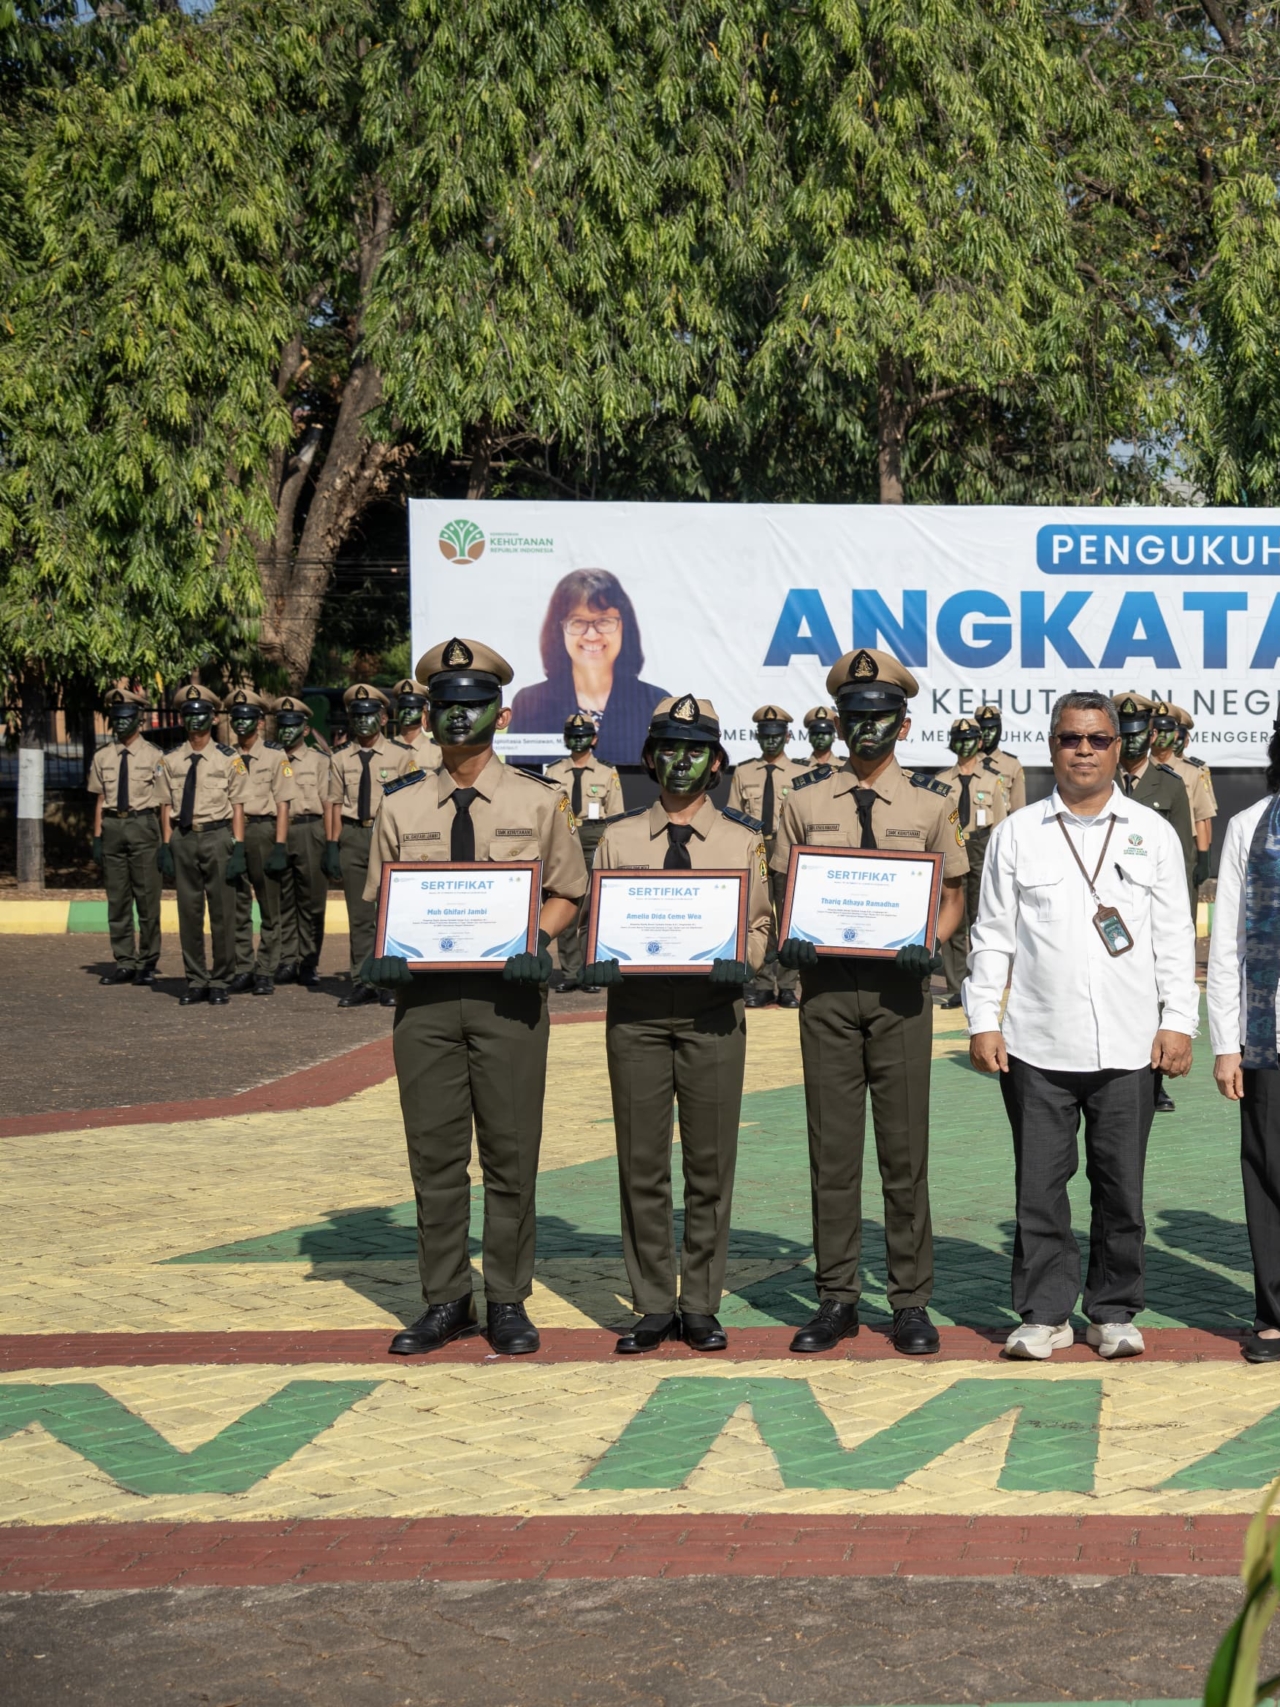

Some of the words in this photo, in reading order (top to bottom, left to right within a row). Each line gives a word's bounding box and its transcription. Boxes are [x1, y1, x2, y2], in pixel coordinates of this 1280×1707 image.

[490, 538, 554, 546] KEHUTANAN
[827, 870, 897, 882] SERTIFIKAT
[421, 880, 495, 890] SERTIFIKAT
[628, 887, 700, 896] SERTIFIKAT
[821, 897, 841, 906] Thariq
[842, 898, 864, 907] Athaya
[865, 899, 900, 908] Ramadhan
[427, 908, 442, 916] Muh
[443, 907, 466, 916] Ghifari
[467, 907, 487, 915] Jambi
